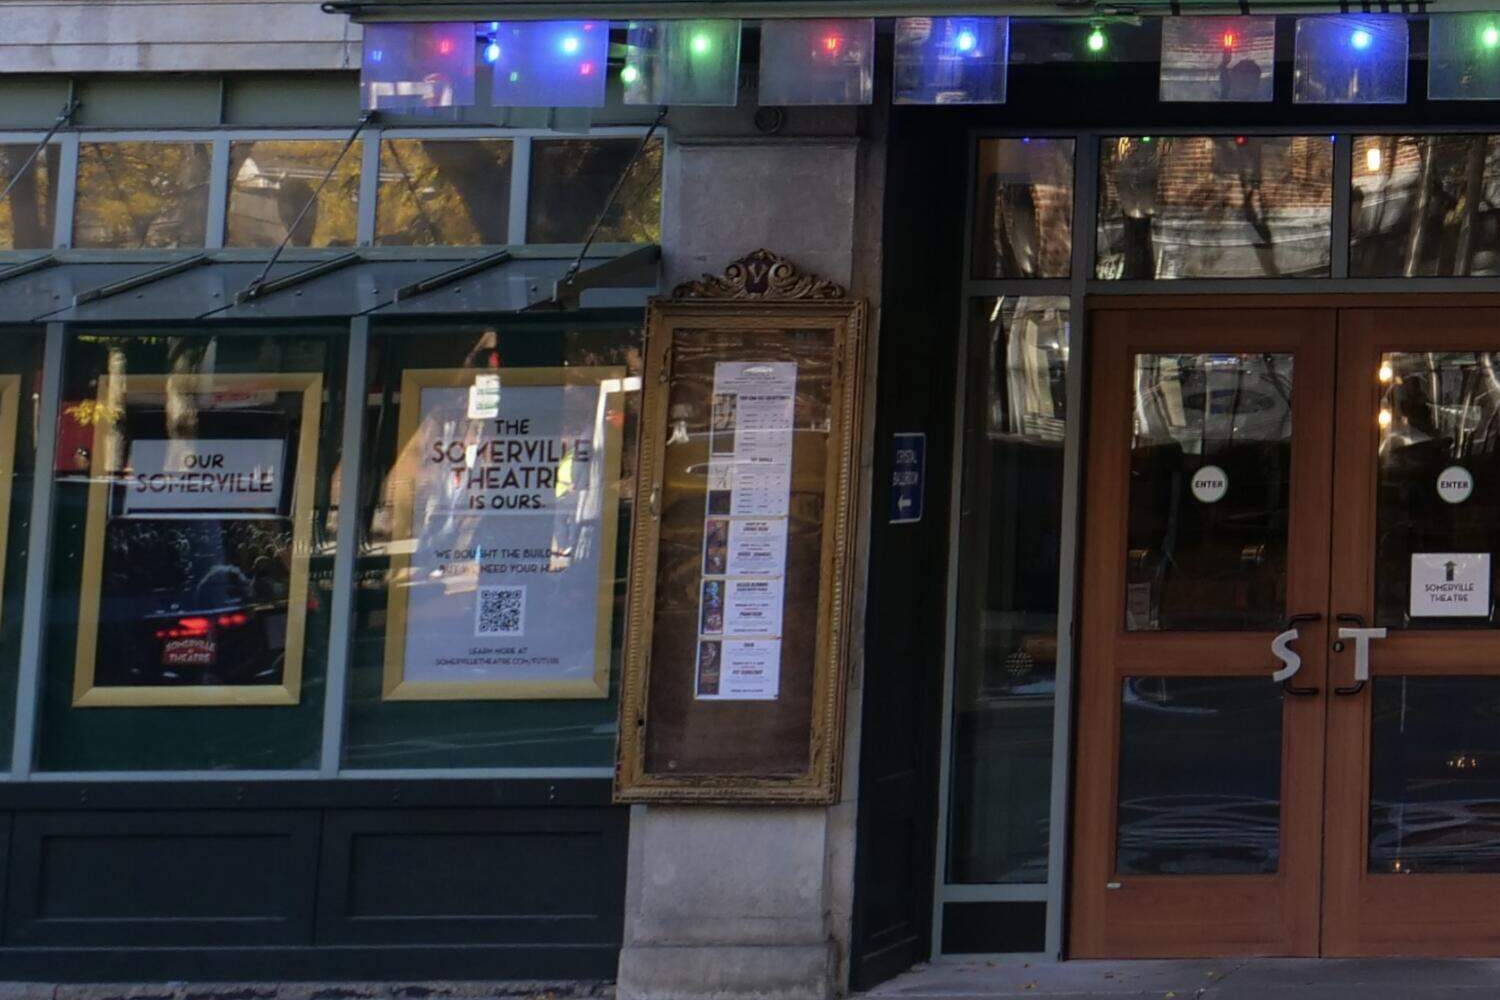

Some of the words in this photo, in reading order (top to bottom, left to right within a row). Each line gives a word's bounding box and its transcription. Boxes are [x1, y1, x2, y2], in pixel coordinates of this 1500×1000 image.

[494, 418, 530, 434] THE
[184, 454, 224, 468] OUR
[136, 473, 274, 493] SOMERVILLE
[451, 467, 567, 489] THEATR
[469, 495, 485, 509] IS
[502, 549, 519, 559] THE
[523, 549, 572, 559] BUILD
[510, 564, 537, 574] YOUR
[1425, 584, 1474, 592] SOMERVILLE
[1430, 595, 1469, 603] THEATRE
[1271, 629, 1301, 682] S
[1338, 628, 1387, 681] T
